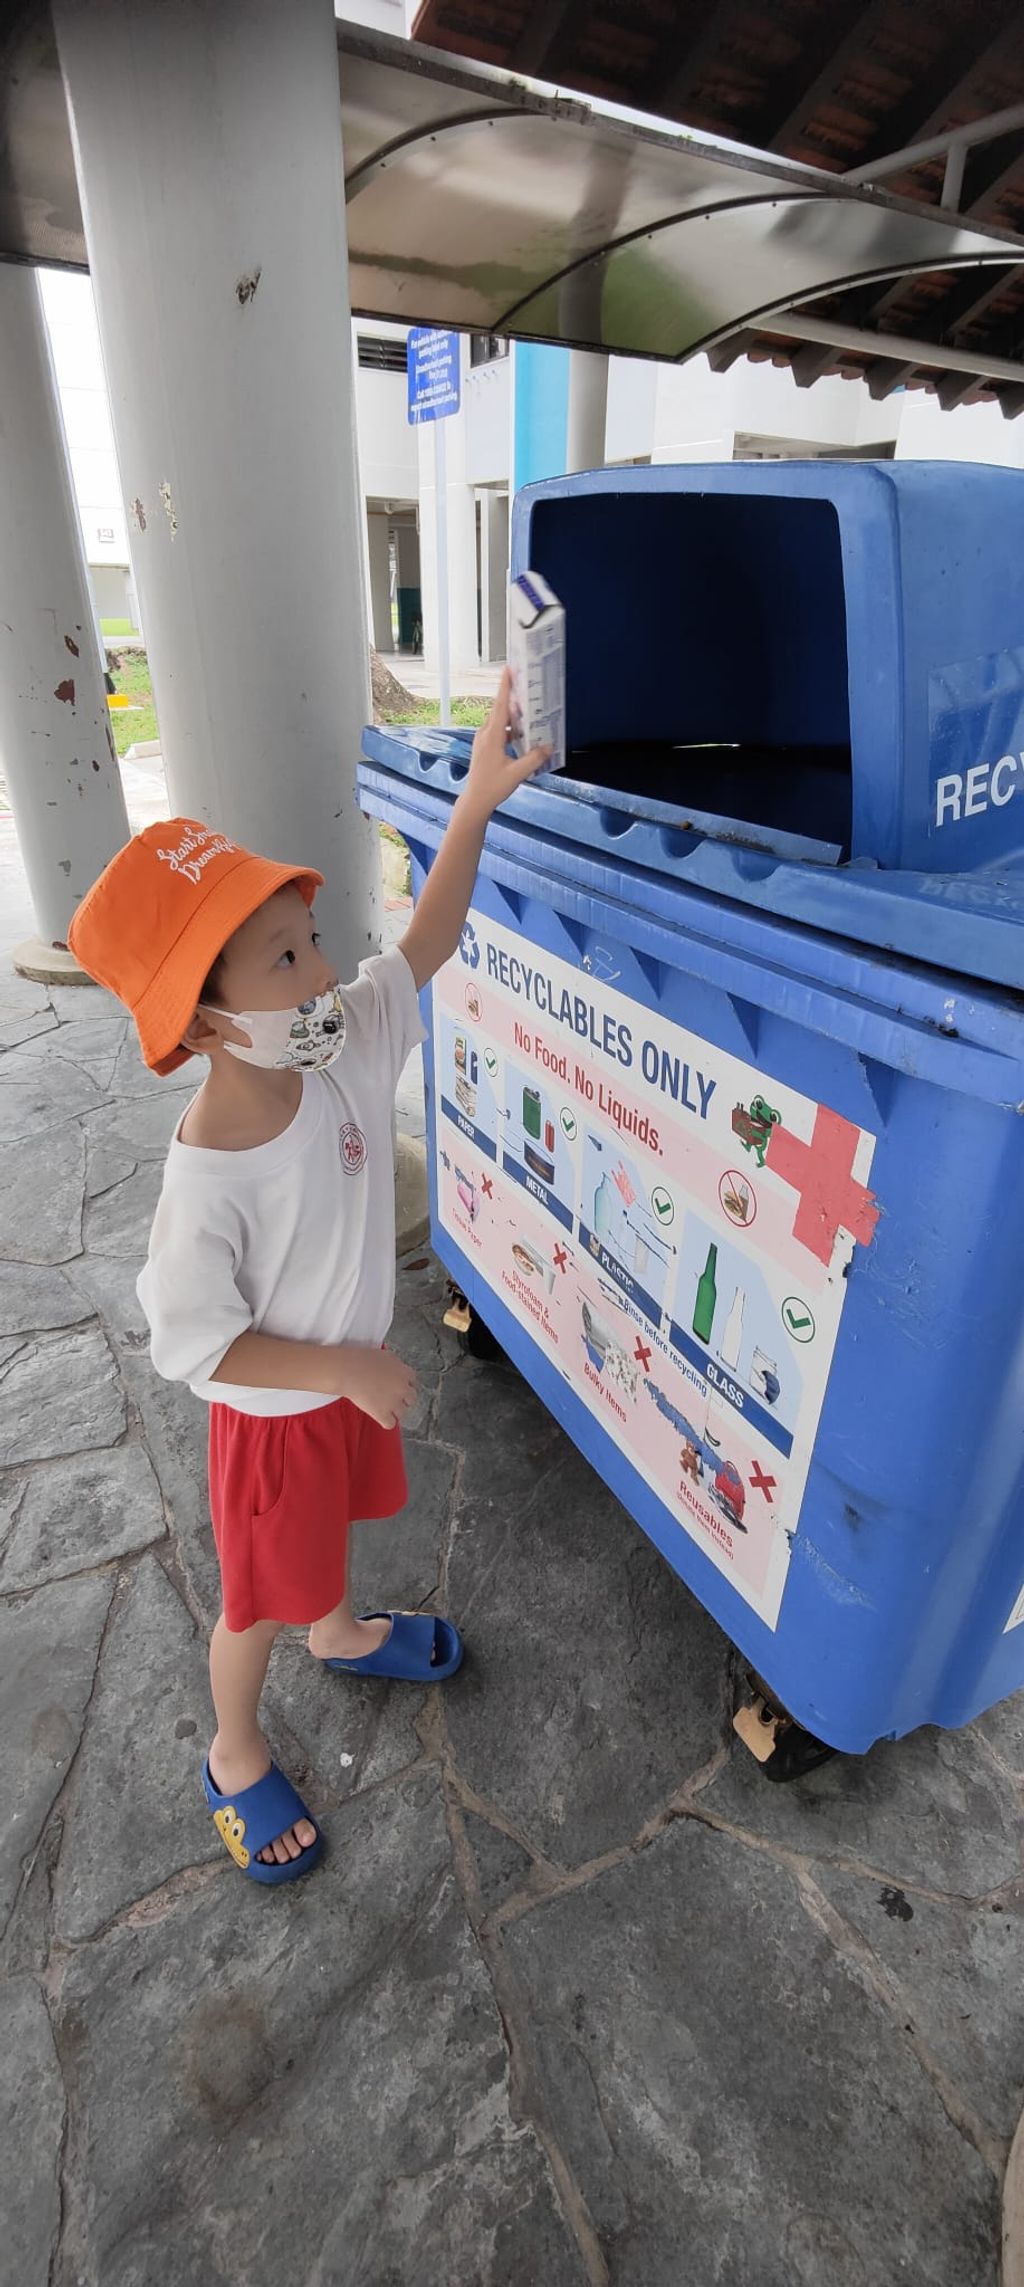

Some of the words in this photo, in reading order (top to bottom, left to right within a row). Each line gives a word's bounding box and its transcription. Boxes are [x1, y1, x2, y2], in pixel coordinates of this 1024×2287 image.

[935, 751, 1024, 827] REC
[486, 943, 633, 1068] RECYCLABLES
[641, 1040, 717, 1120] ONLY
[514, 1022, 531, 1053] No
[534, 1036, 571, 1084] Food.
[575, 1065, 594, 1101] No
[599, 1084, 664, 1156] Liquids.
[525, 1175, 549, 1206] METAL
[583, 1362, 605, 1395] Bulky
[645, 1322, 668, 1353] before
[669, 1350, 708, 1398] recycling
[706, 1364, 744, 1408] GLASS
[680, 1480, 733, 1548] Reusables
